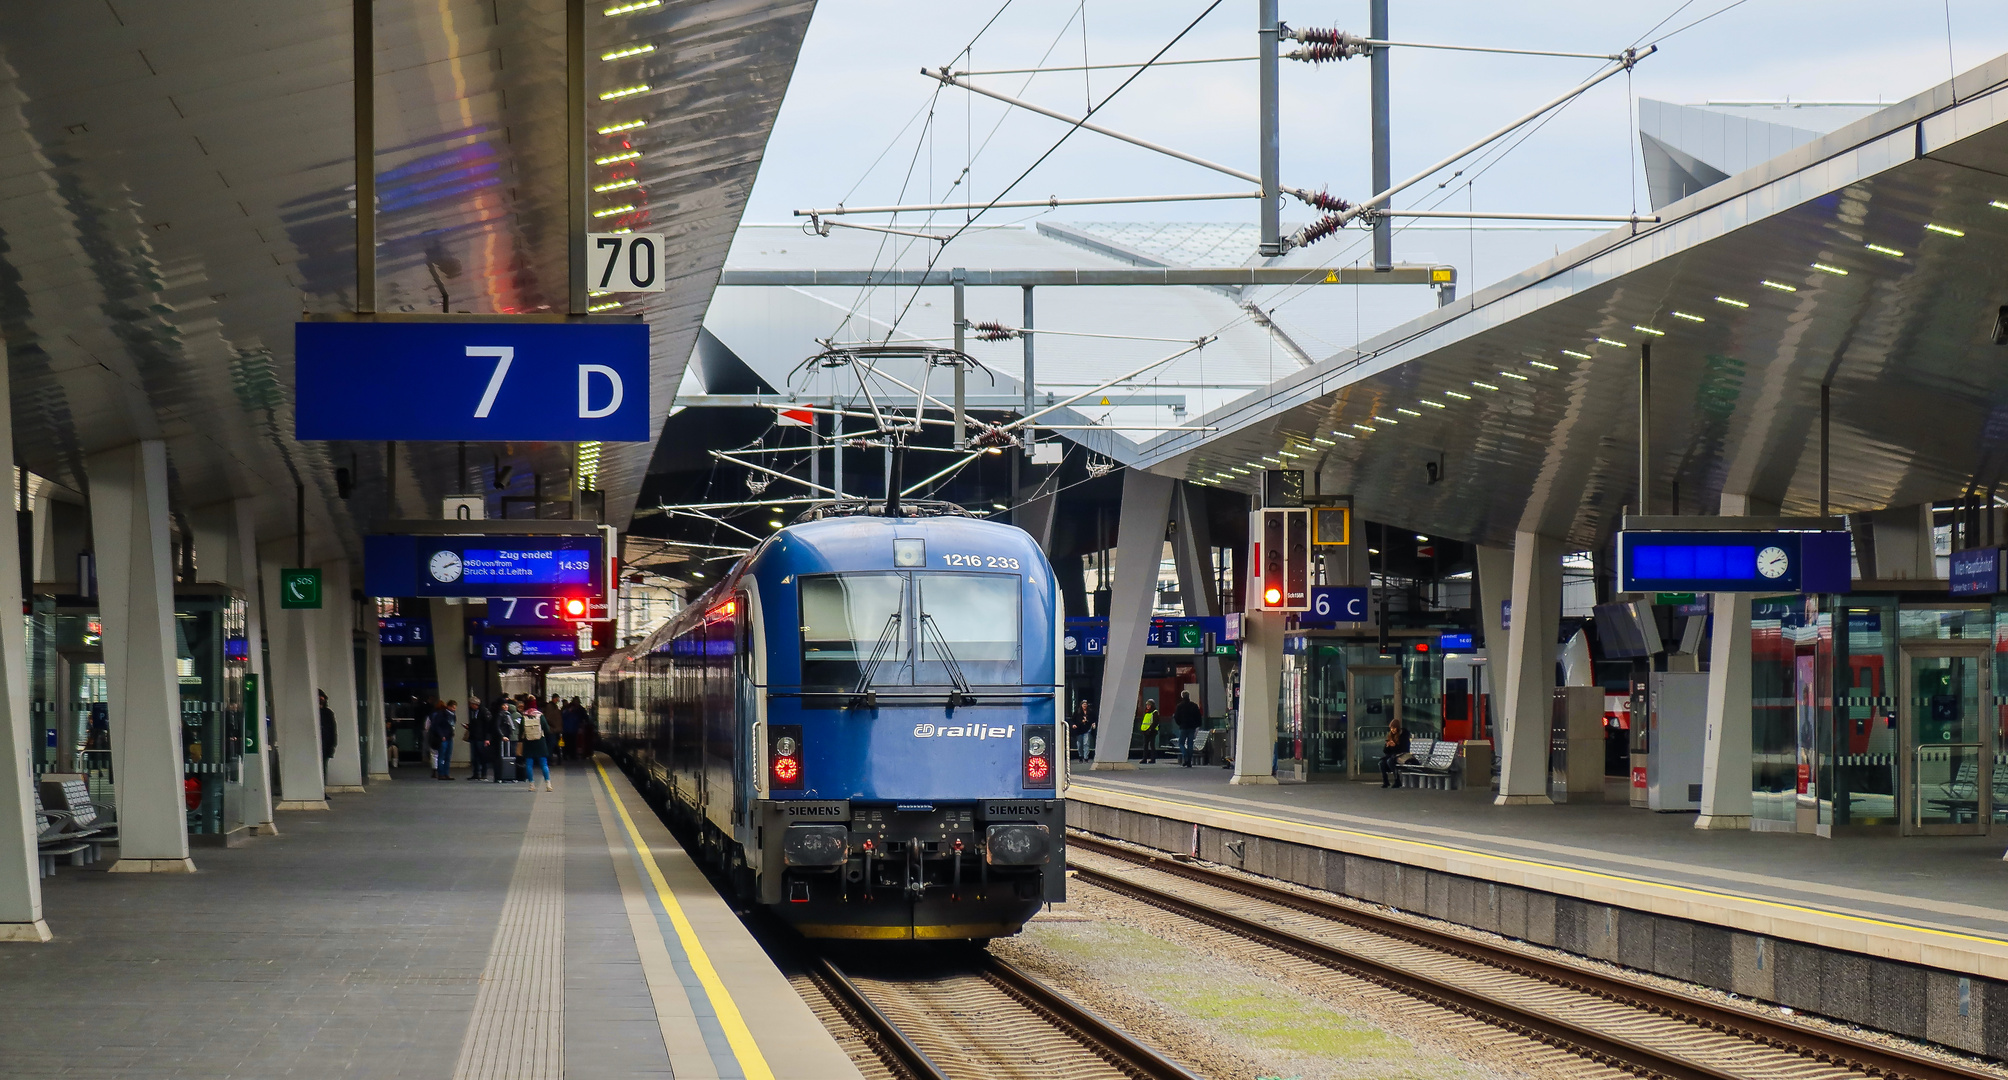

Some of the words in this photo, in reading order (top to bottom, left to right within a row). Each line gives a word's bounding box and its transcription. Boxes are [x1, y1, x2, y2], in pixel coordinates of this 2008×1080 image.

[596, 237, 655, 288] 70
[465, 345, 514, 418] 7
[578, 364, 624, 419] D
[499, 550, 519, 560] Zug
[521, 550, 552, 559] endet!
[942, 553, 982, 567] 1216
[986, 555, 1020, 570] 233
[463, 568, 488, 576] Bruck
[559, 561, 589, 570] 14:39
[502, 597, 518, 619] 7
[534, 602, 549, 619] C
[1315, 593, 1330, 616] 6
[1347, 598, 1360, 616] C
[936, 723, 1016, 740] railjet
[788, 806, 841, 816] SIEMENS
[988, 805, 1041, 815] SIEMENS
